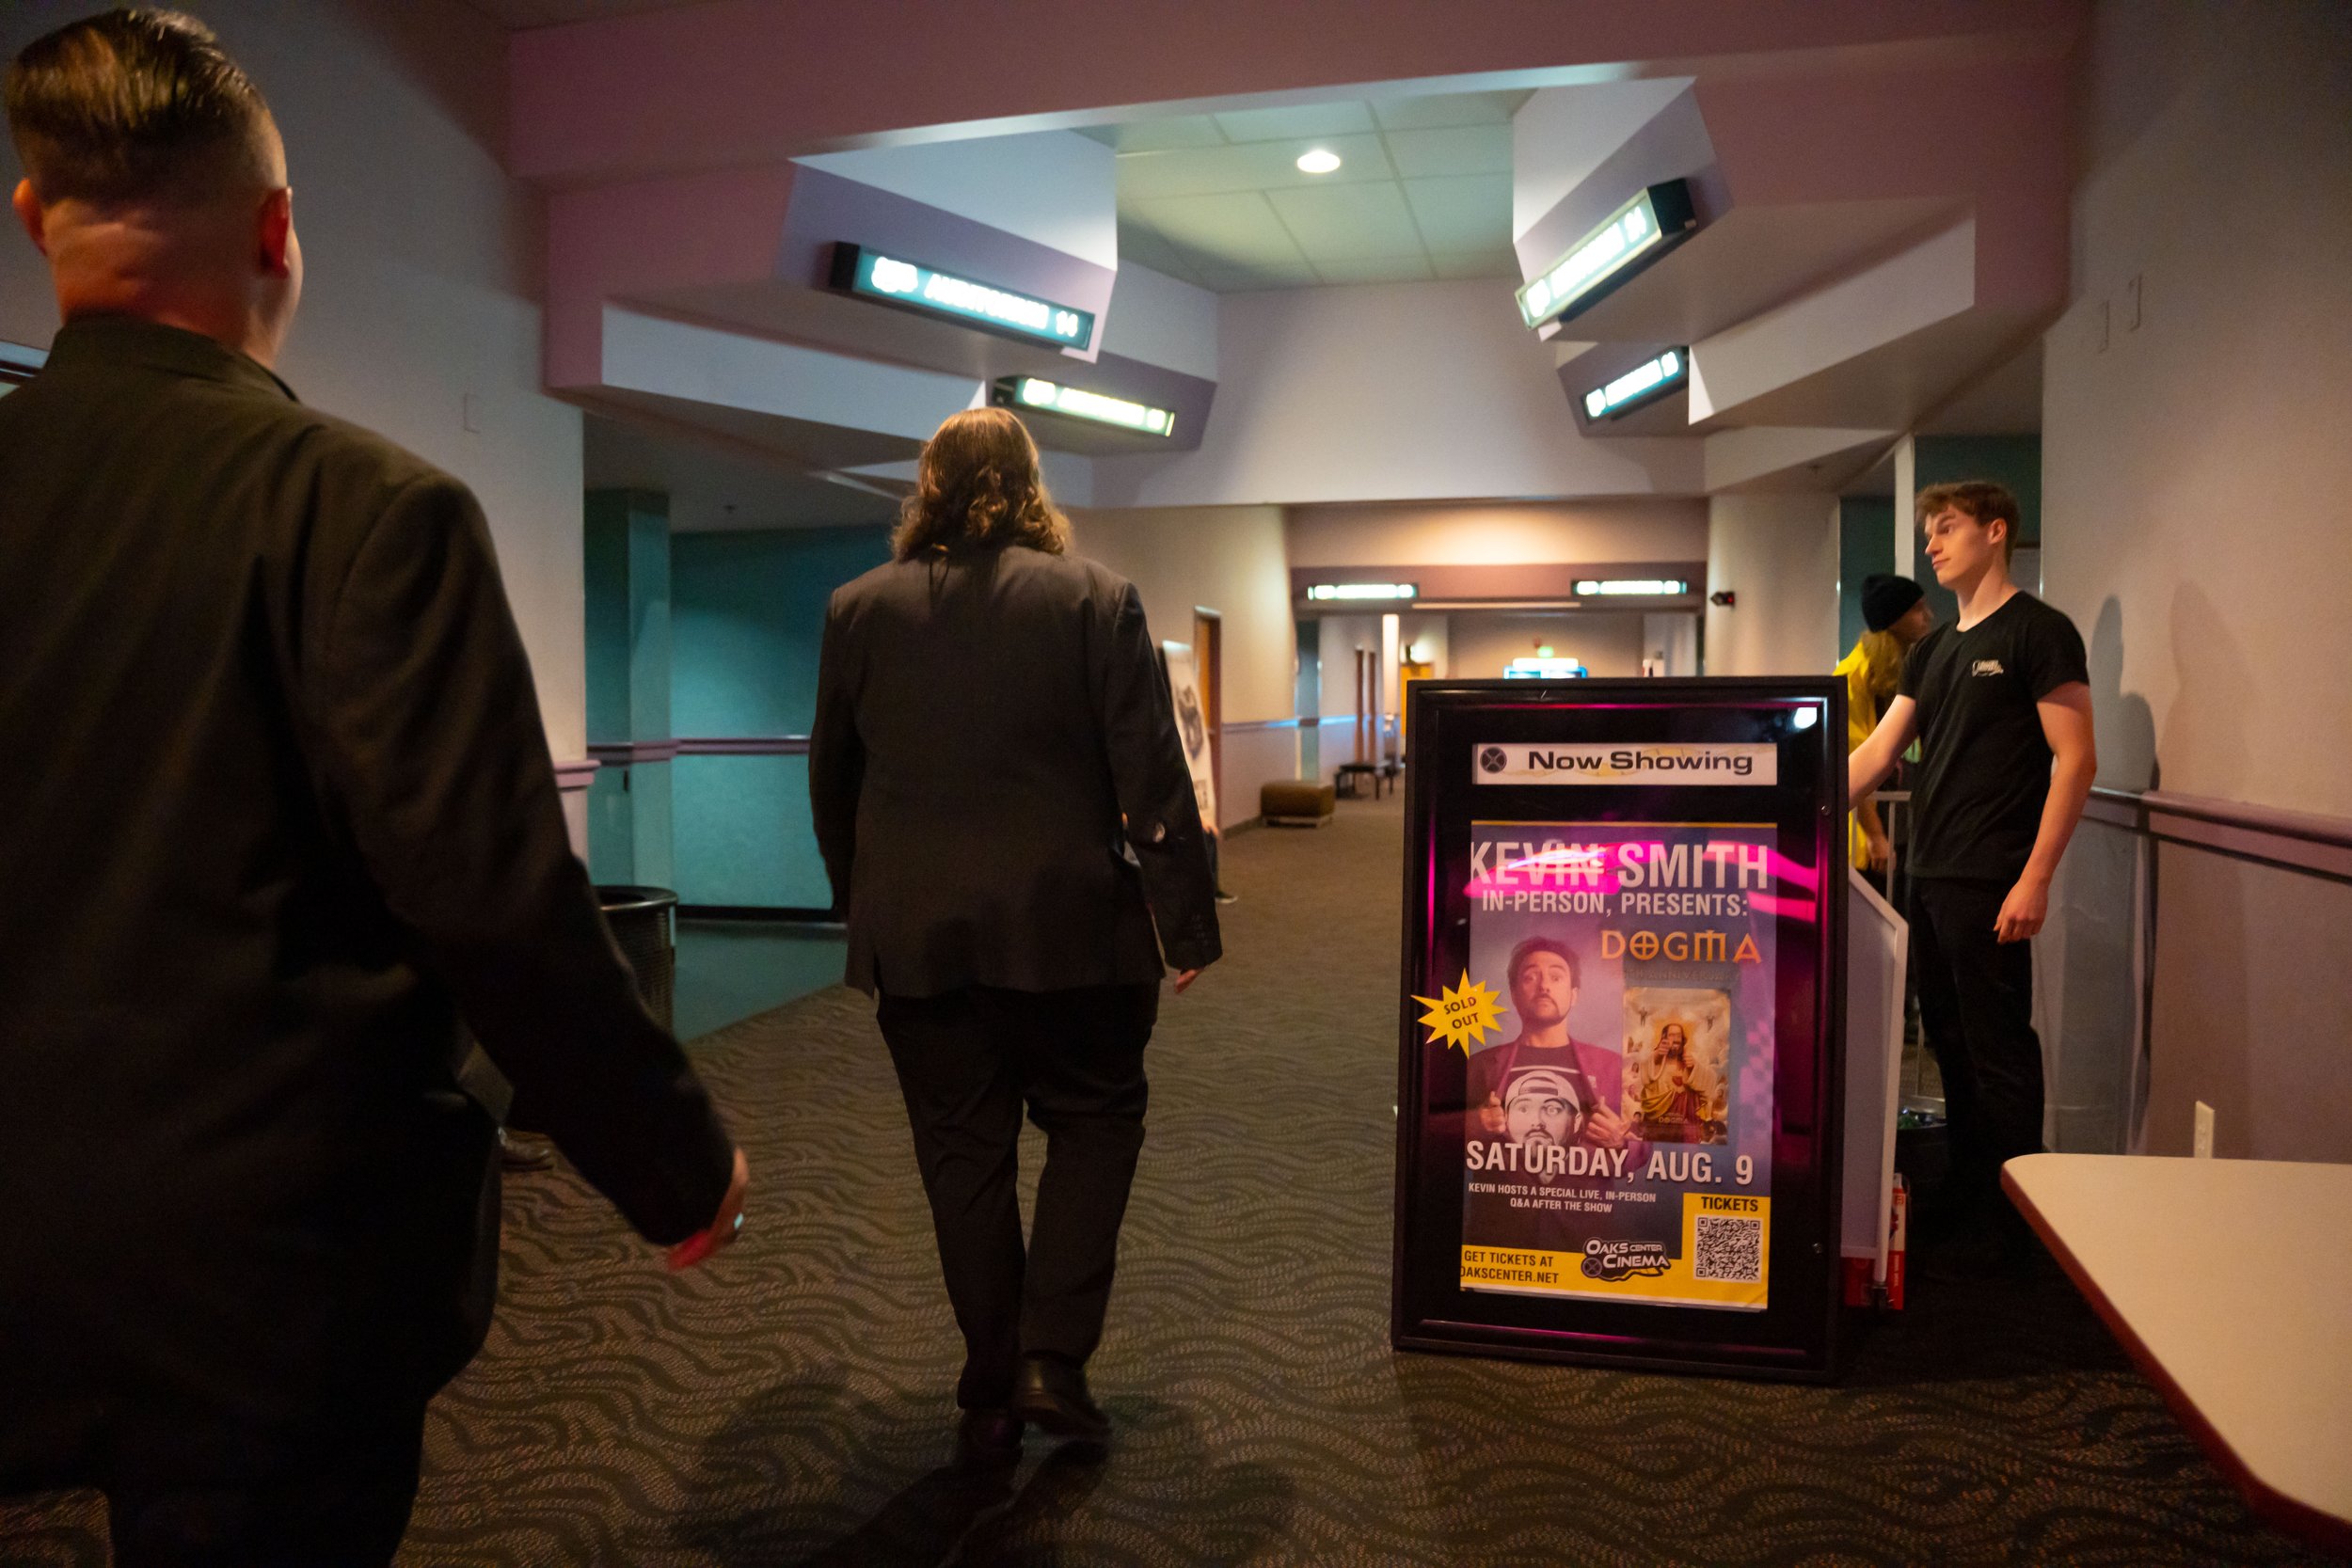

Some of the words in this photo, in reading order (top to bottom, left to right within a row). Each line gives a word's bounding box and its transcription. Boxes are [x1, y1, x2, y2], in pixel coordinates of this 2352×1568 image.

[1529, 752, 1602, 769] Now
[1610, 752, 1752, 776] Showing
[1470, 840, 1599, 886] KEVIN
[1617, 843, 1768, 889] SMITH
[1483, 890, 1612, 917] IN-PERSON,
[1621, 892, 1748, 916] PRESENTS:
[1600, 929, 1761, 963] DOGMA
[1443, 996, 1477, 1015] SOLD
[1452, 1012, 1479, 1029] OUT
[1466, 1140, 1634, 1182] SATURDAY,
[1646, 1150, 1723, 1183] AUG.
[1736, 1155, 1753, 1185] 9
[1469, 1182, 1495, 1193] KEVIN
[1498, 1184, 1528, 1196] HOSTS
[1530, 1186, 1537, 1196] A
[1539, 1186, 1577, 1198] SPECIAL
[1605, 1190, 1656, 1203] IN-PERSON
[1510, 1197, 1531, 1208] Q&A
[1532, 1199, 1562, 1210] AFTER
[1564, 1200, 1581, 1211] THE
[1584, 1201, 1613, 1212] SHOW
[1701, 1196, 1759, 1212] TICKETS
[1586, 1239, 1629, 1255] OAKS
[1629, 1243, 1662, 1252] CENTER
[1464, 1250, 1486, 1262] GET
[1489, 1252, 1536, 1266] TICKETS
[1539, 1256, 1553, 1267] AT
[1602, 1254, 1669, 1269] CINEMA
